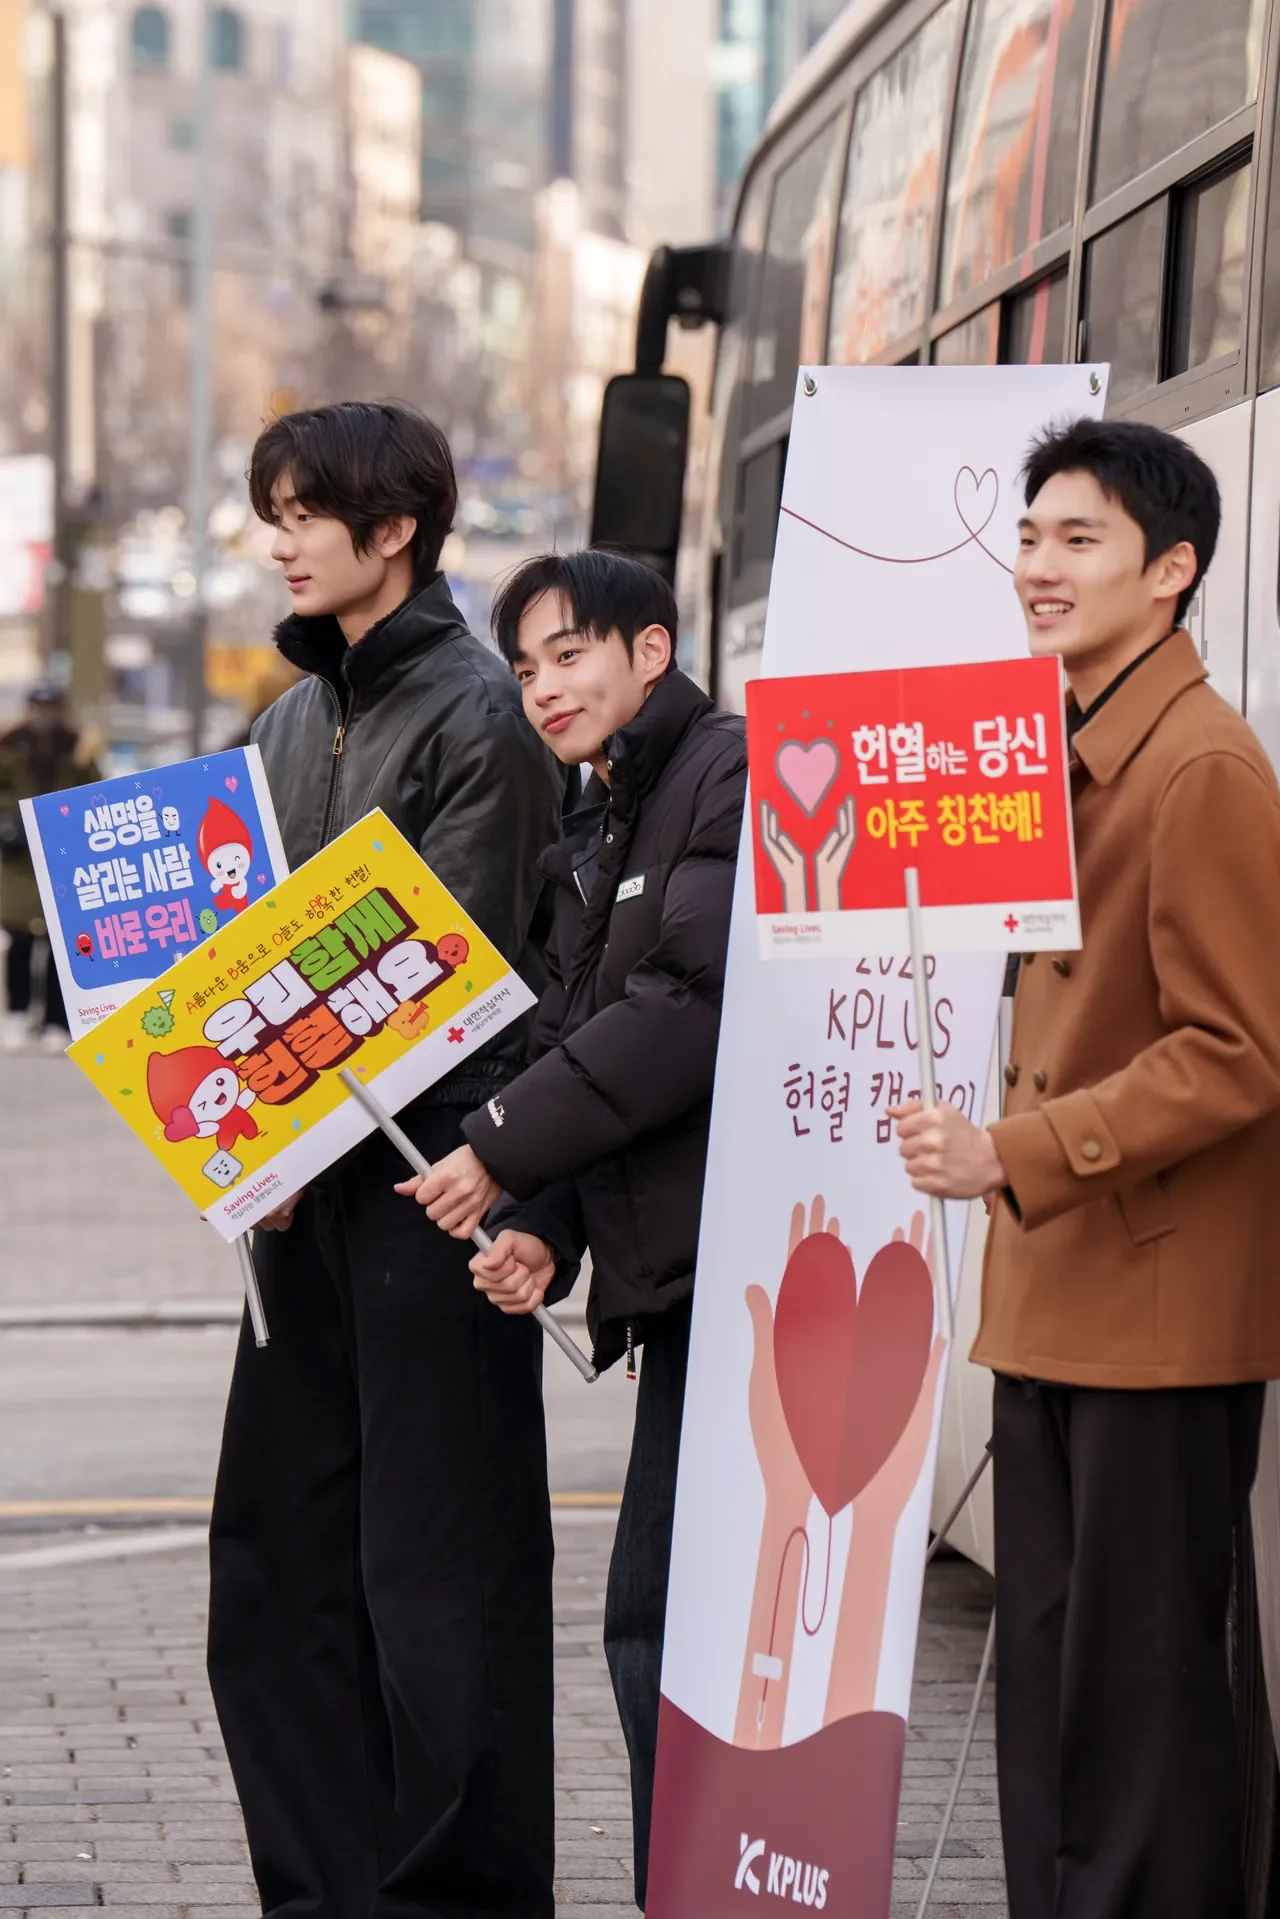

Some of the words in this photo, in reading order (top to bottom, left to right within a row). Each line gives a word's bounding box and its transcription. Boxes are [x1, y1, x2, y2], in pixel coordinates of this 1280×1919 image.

[851, 721, 968, 785] 헌혈하는
[973, 712, 1048, 779] 당신
[84, 795, 162, 852] 생명을
[866, 798, 929, 849] 아주
[936, 790, 1043, 847] 칭찬해!
[73, 857, 143, 911] 살리는
[142, 843, 194, 893] 사람
[94, 910, 148, 960] 바로
[145, 898, 197, 949] 우리
[185, 976, 229, 1015] A름다운
[227, 943, 272, 980] B움으로
[272, 919, 304, 946] O늘도
[344, 863, 372, 889] 헌혈!
[203, 958, 318, 1059] 우리
[290, 888, 409, 992] 함께
[78, 1006, 100, 1017] Saving
[236, 1004, 354, 1104] 헌혈
[327, 939, 445, 1036] 해요
[462, 988, 511, 1026] 대한적십자사
[827, 988, 954, 1059] KPLUS
[783, 1063, 850, 1143] 헌혈
[223, 1190, 255, 1215] Saving
[252, 1173, 279, 1193] Lives,
[766, 1851, 830, 1910] KPLUS
